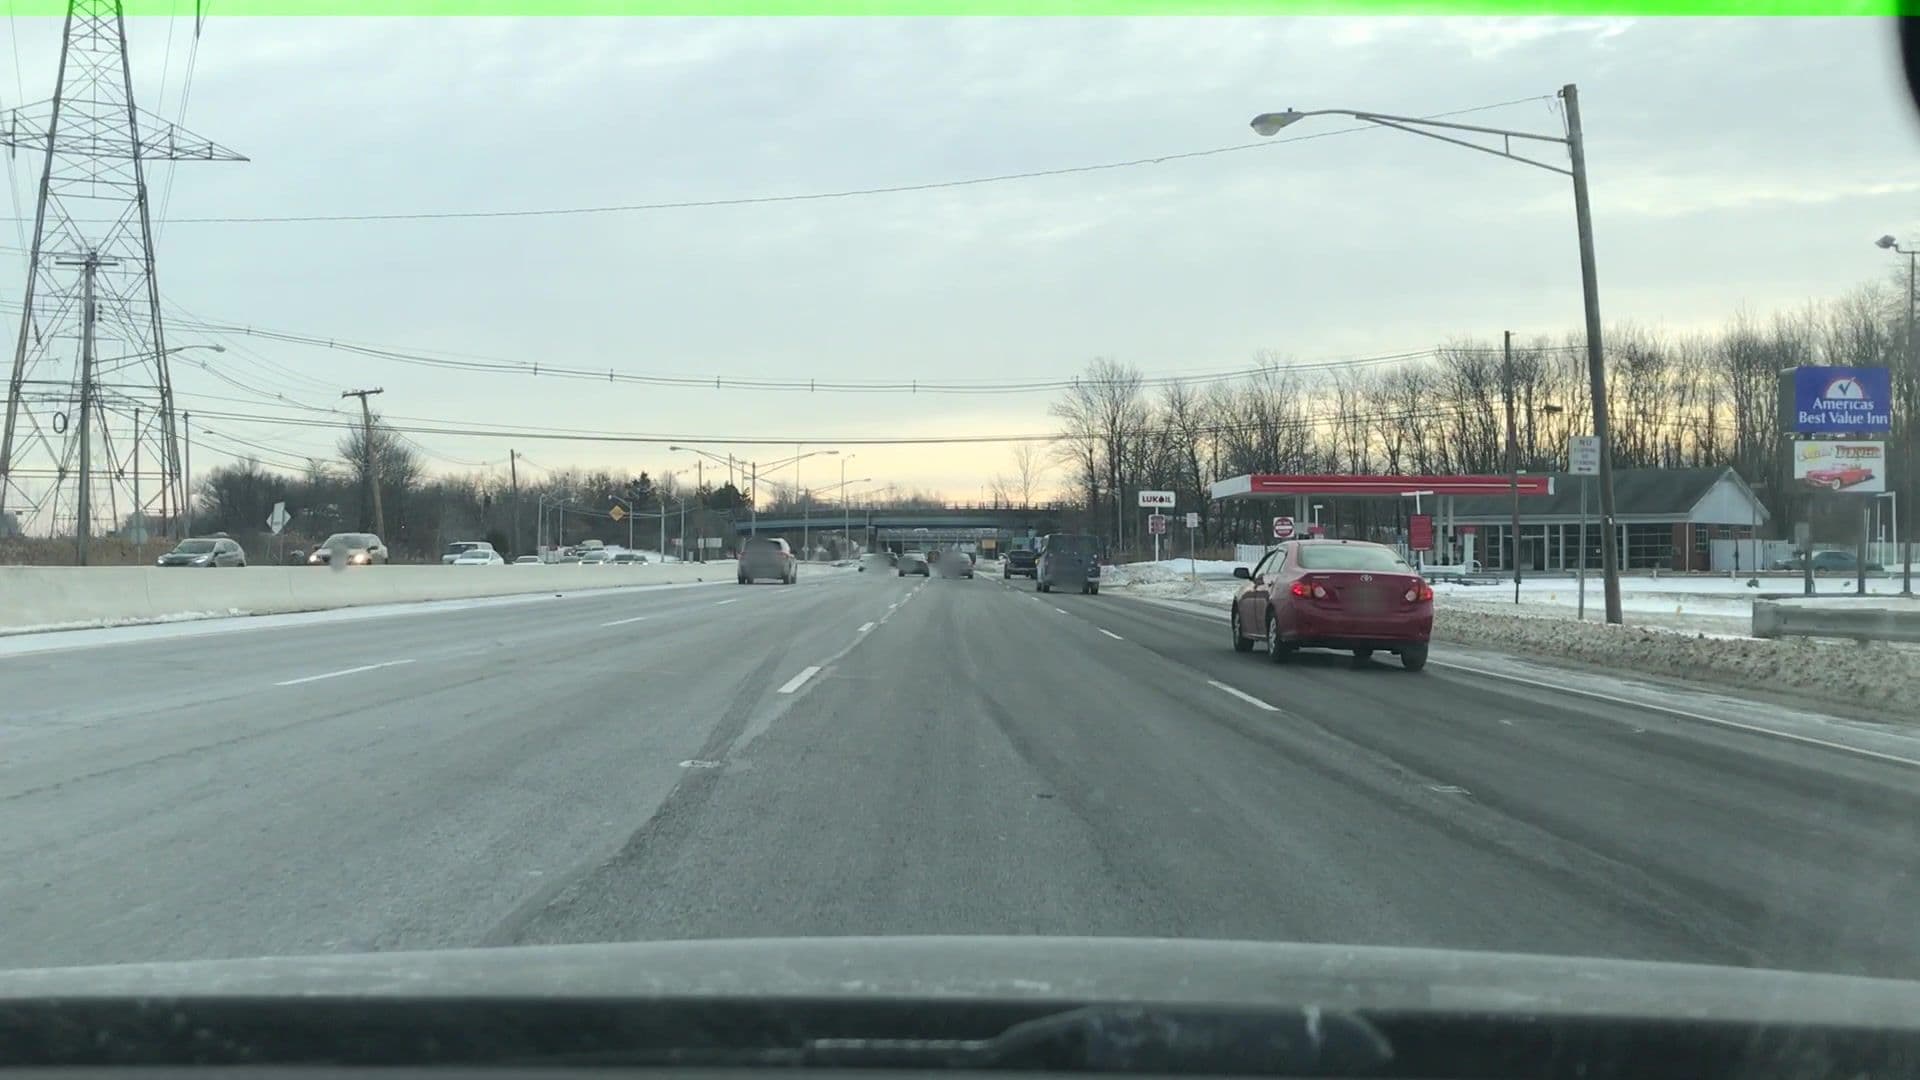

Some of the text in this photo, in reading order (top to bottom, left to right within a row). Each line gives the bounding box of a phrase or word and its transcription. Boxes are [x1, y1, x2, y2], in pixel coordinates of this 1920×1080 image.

[1813, 397, 1874, 410] Americas
[1799, 411, 1888, 424] Best Value Inn
[1142, 495, 1172, 503] LUKOIL
